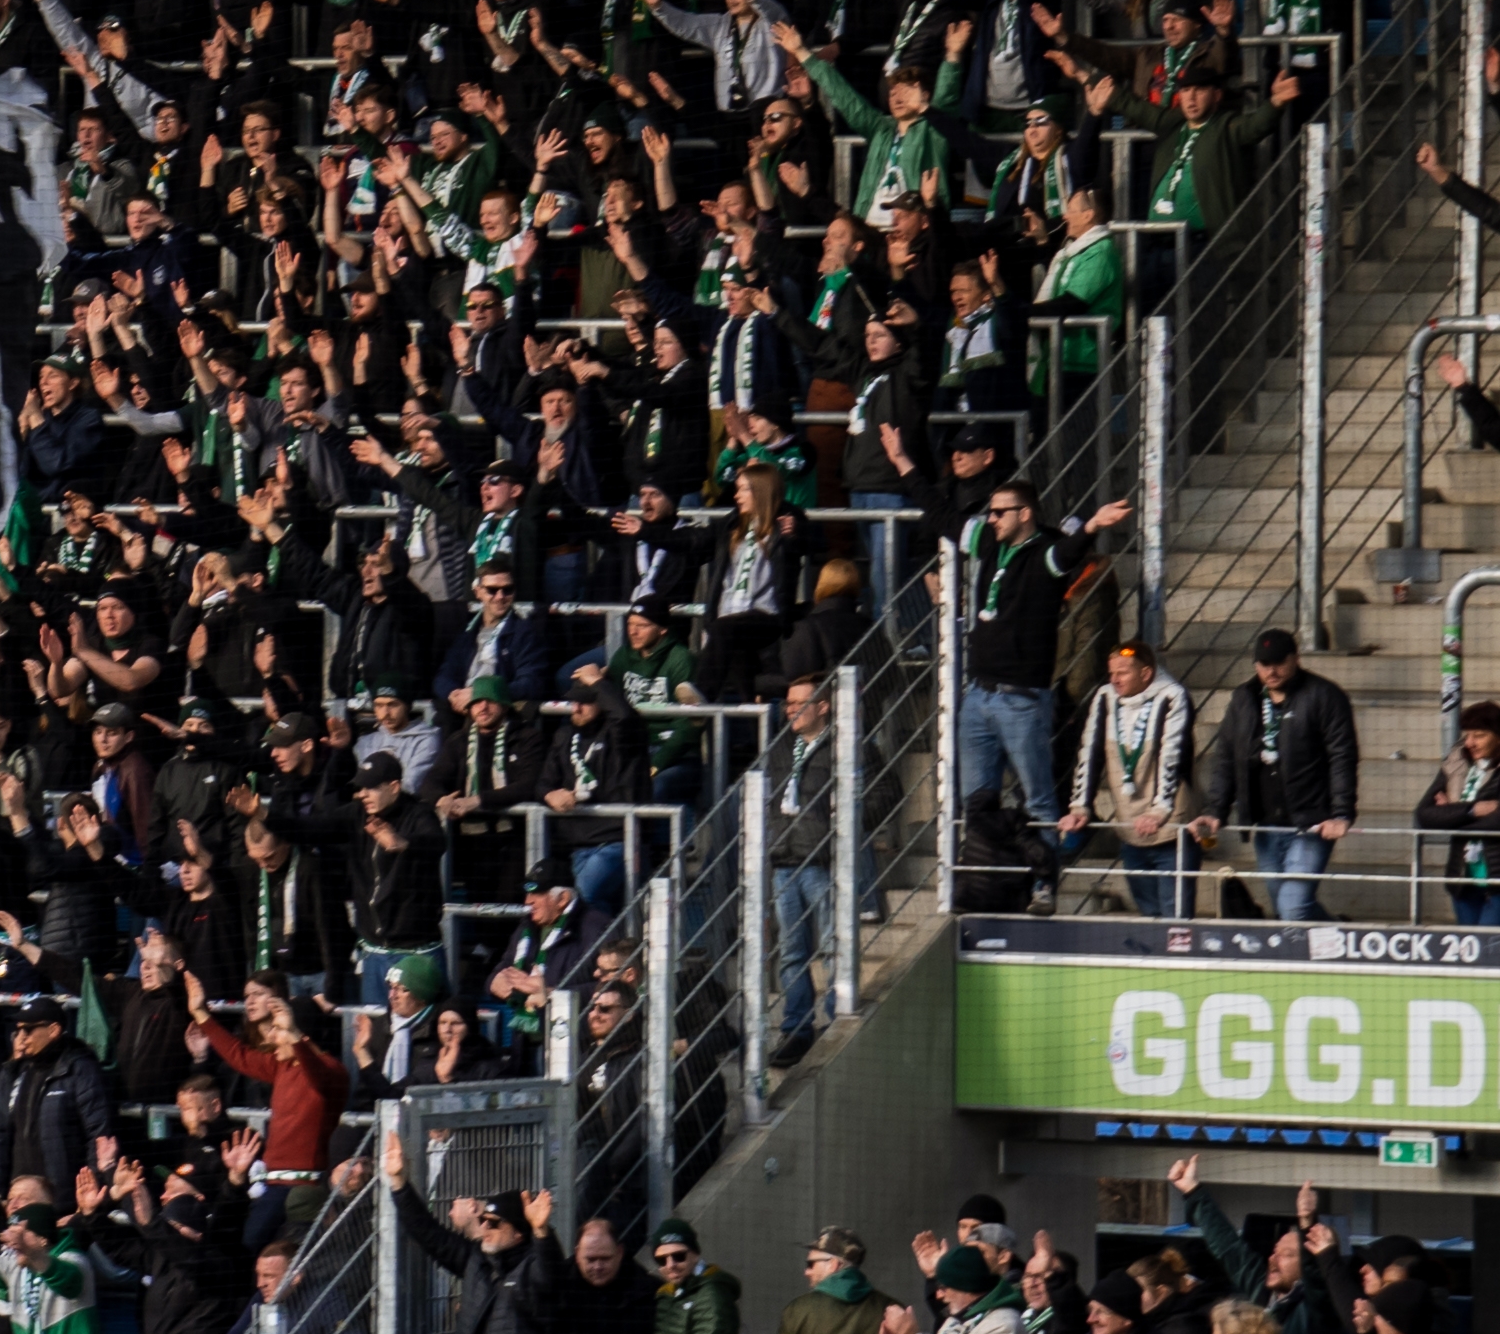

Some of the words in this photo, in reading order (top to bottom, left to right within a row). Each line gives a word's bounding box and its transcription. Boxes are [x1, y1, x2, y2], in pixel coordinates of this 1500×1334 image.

[1329, 929, 1433, 961] BLOCK
[1438, 933, 1481, 963] 20
[1108, 989, 1500, 1107] GGG.D
